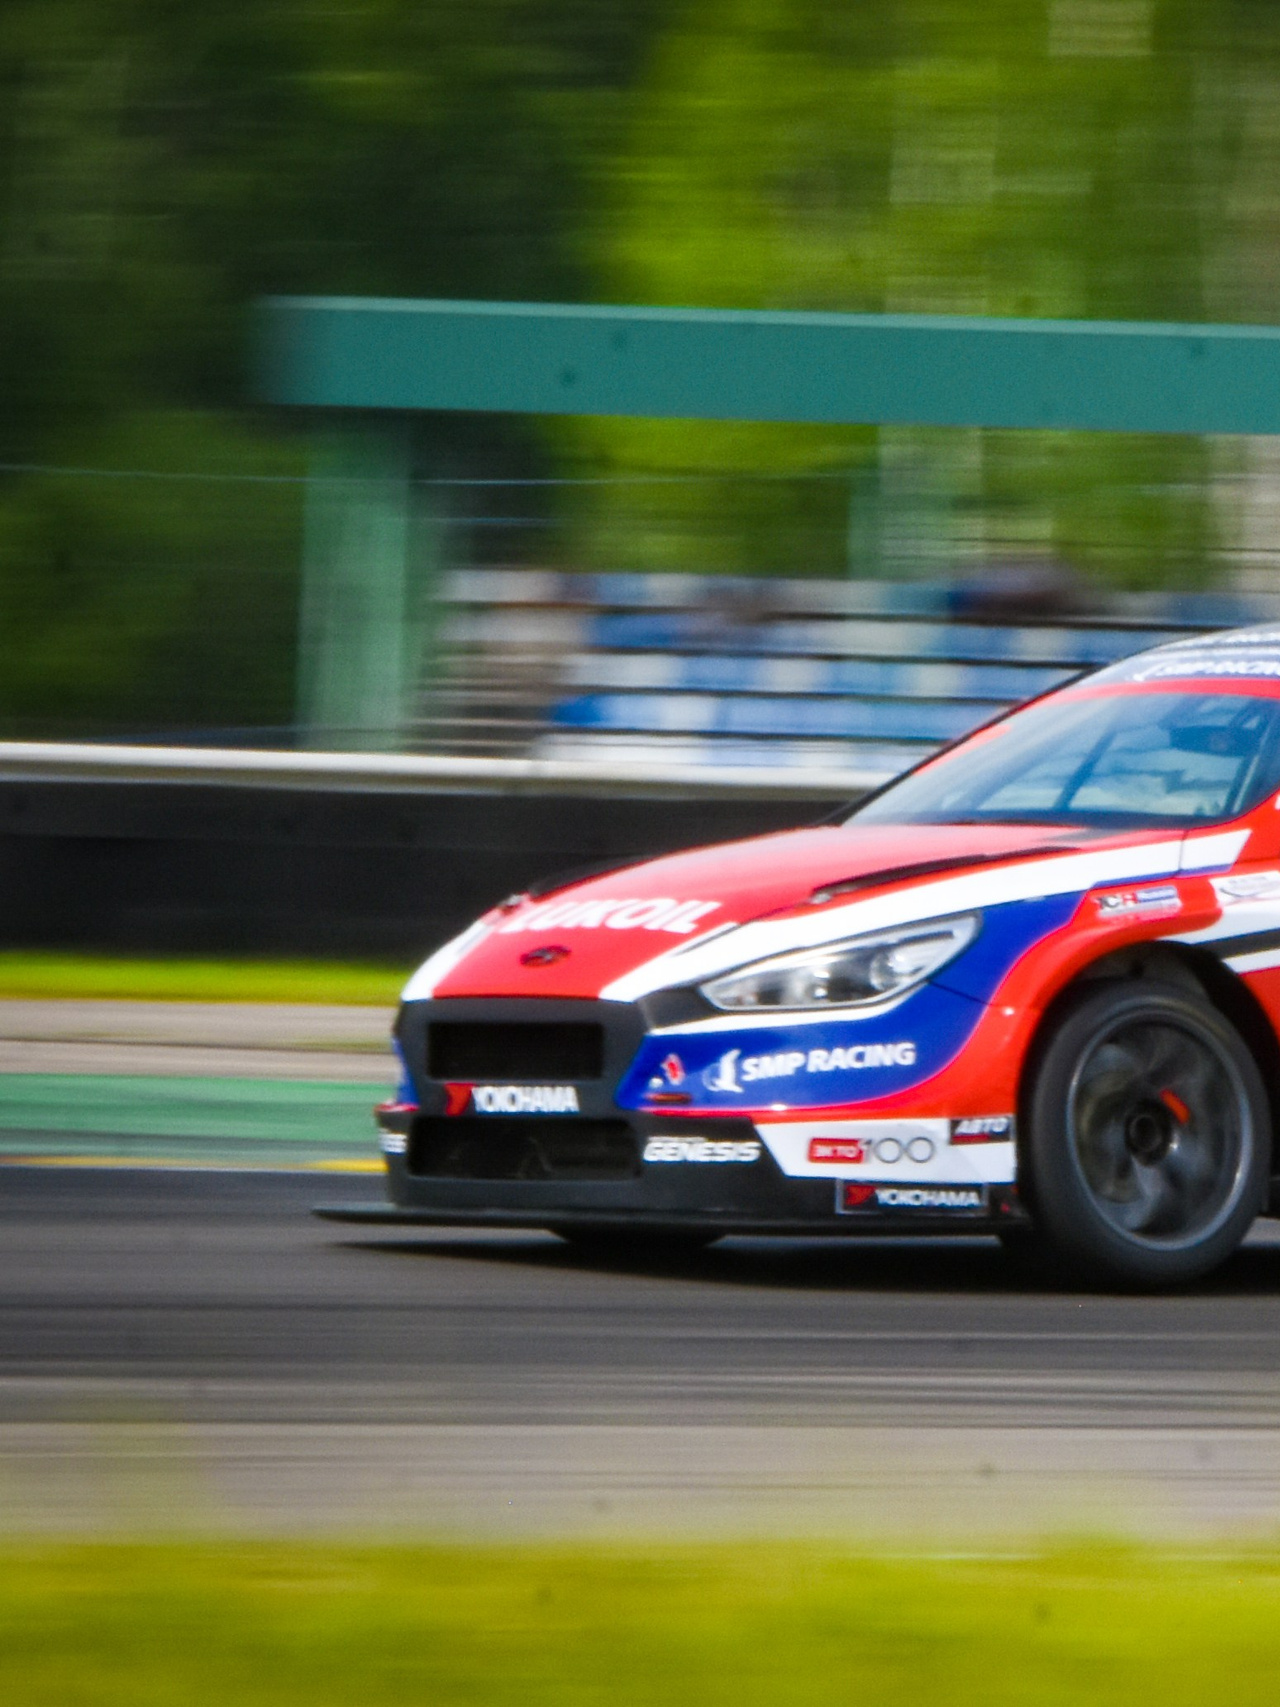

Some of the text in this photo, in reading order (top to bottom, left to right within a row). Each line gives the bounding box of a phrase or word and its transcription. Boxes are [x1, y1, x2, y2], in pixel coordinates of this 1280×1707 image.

[499, 898, 722, 934] LUKOIL
[741, 1041, 917, 1082] SMP RACING
[472, 1086, 579, 1112] YOKOHAMA
[643, 1141, 761, 1161] GENESIS
[859, 1137, 935, 1163] 100
[875, 1188, 981, 1206] YOKOHAMA
